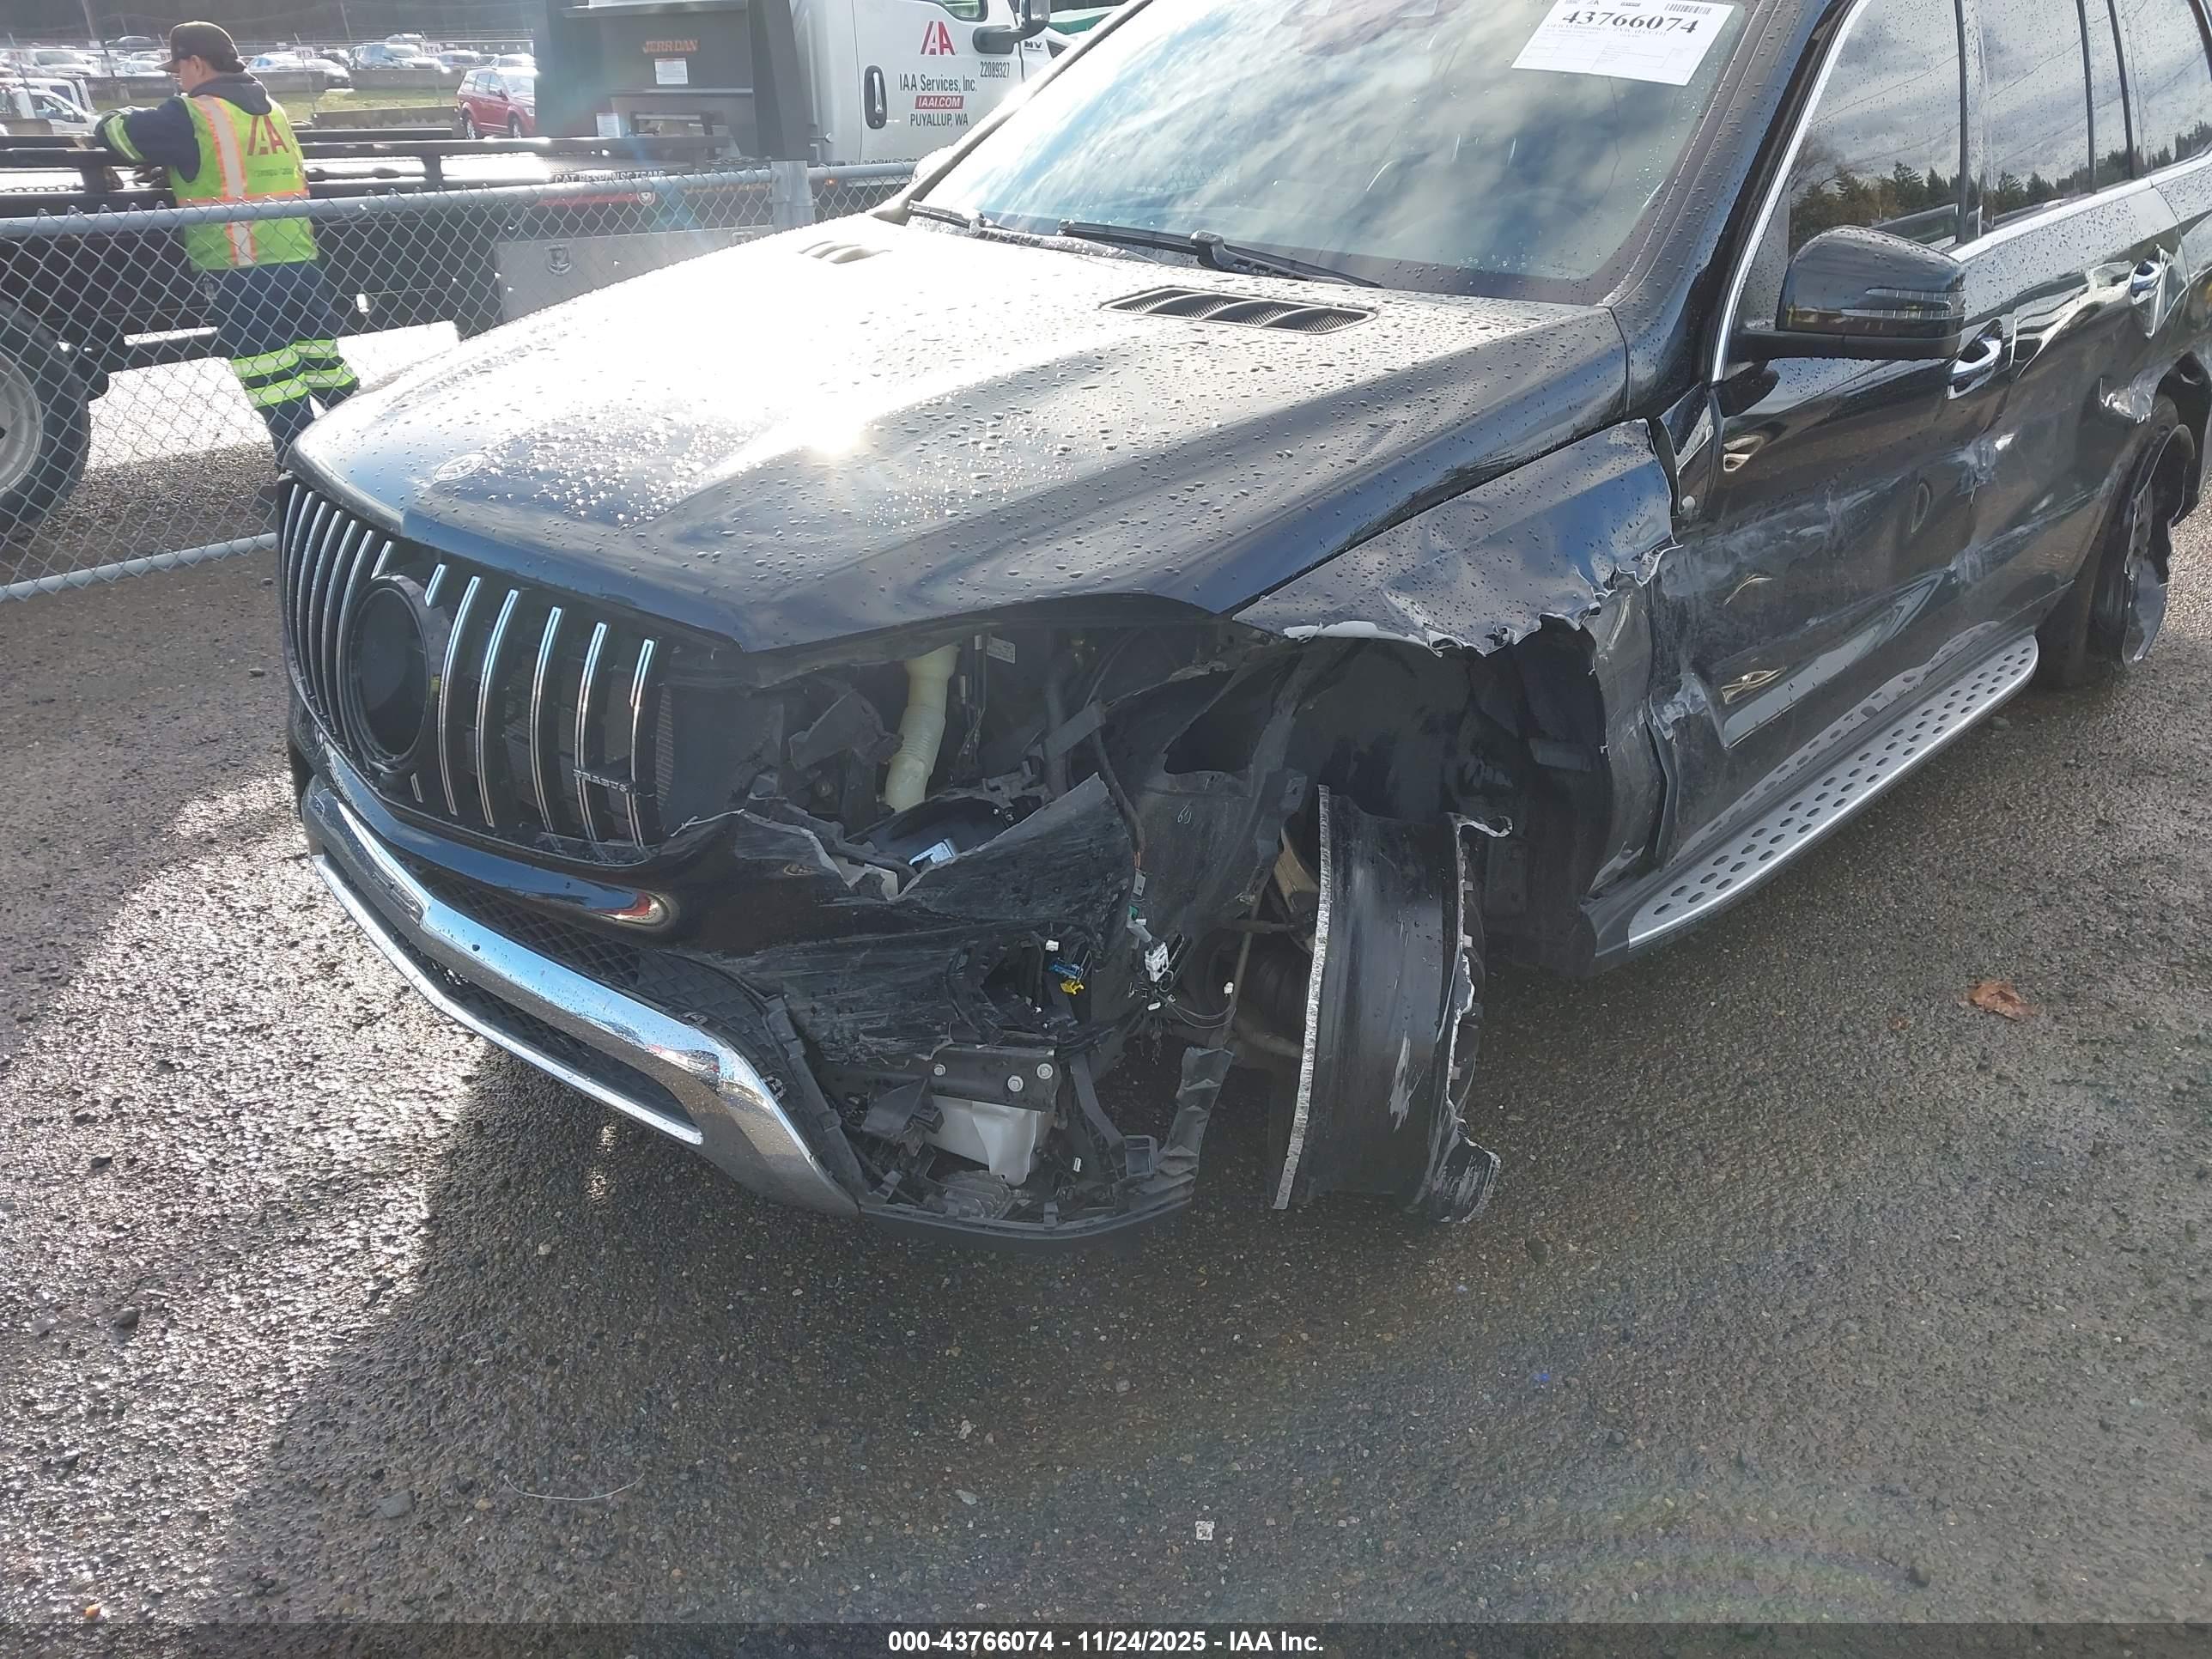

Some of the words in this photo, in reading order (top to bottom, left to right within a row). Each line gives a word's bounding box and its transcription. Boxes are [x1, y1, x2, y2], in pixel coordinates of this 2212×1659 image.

[1562, 9, 1699, 34] 43766074
[980, 61, 1011, 79] 22089327
[899, 73, 918, 92] IAA
[921, 74, 961, 94] Services,
[963, 75, 977, 92] Inc.
[918, 96, 961, 108] IAAI.COM
[910, 113, 953, 126] PUYALLUP,
[955, 113, 969, 126] WA
